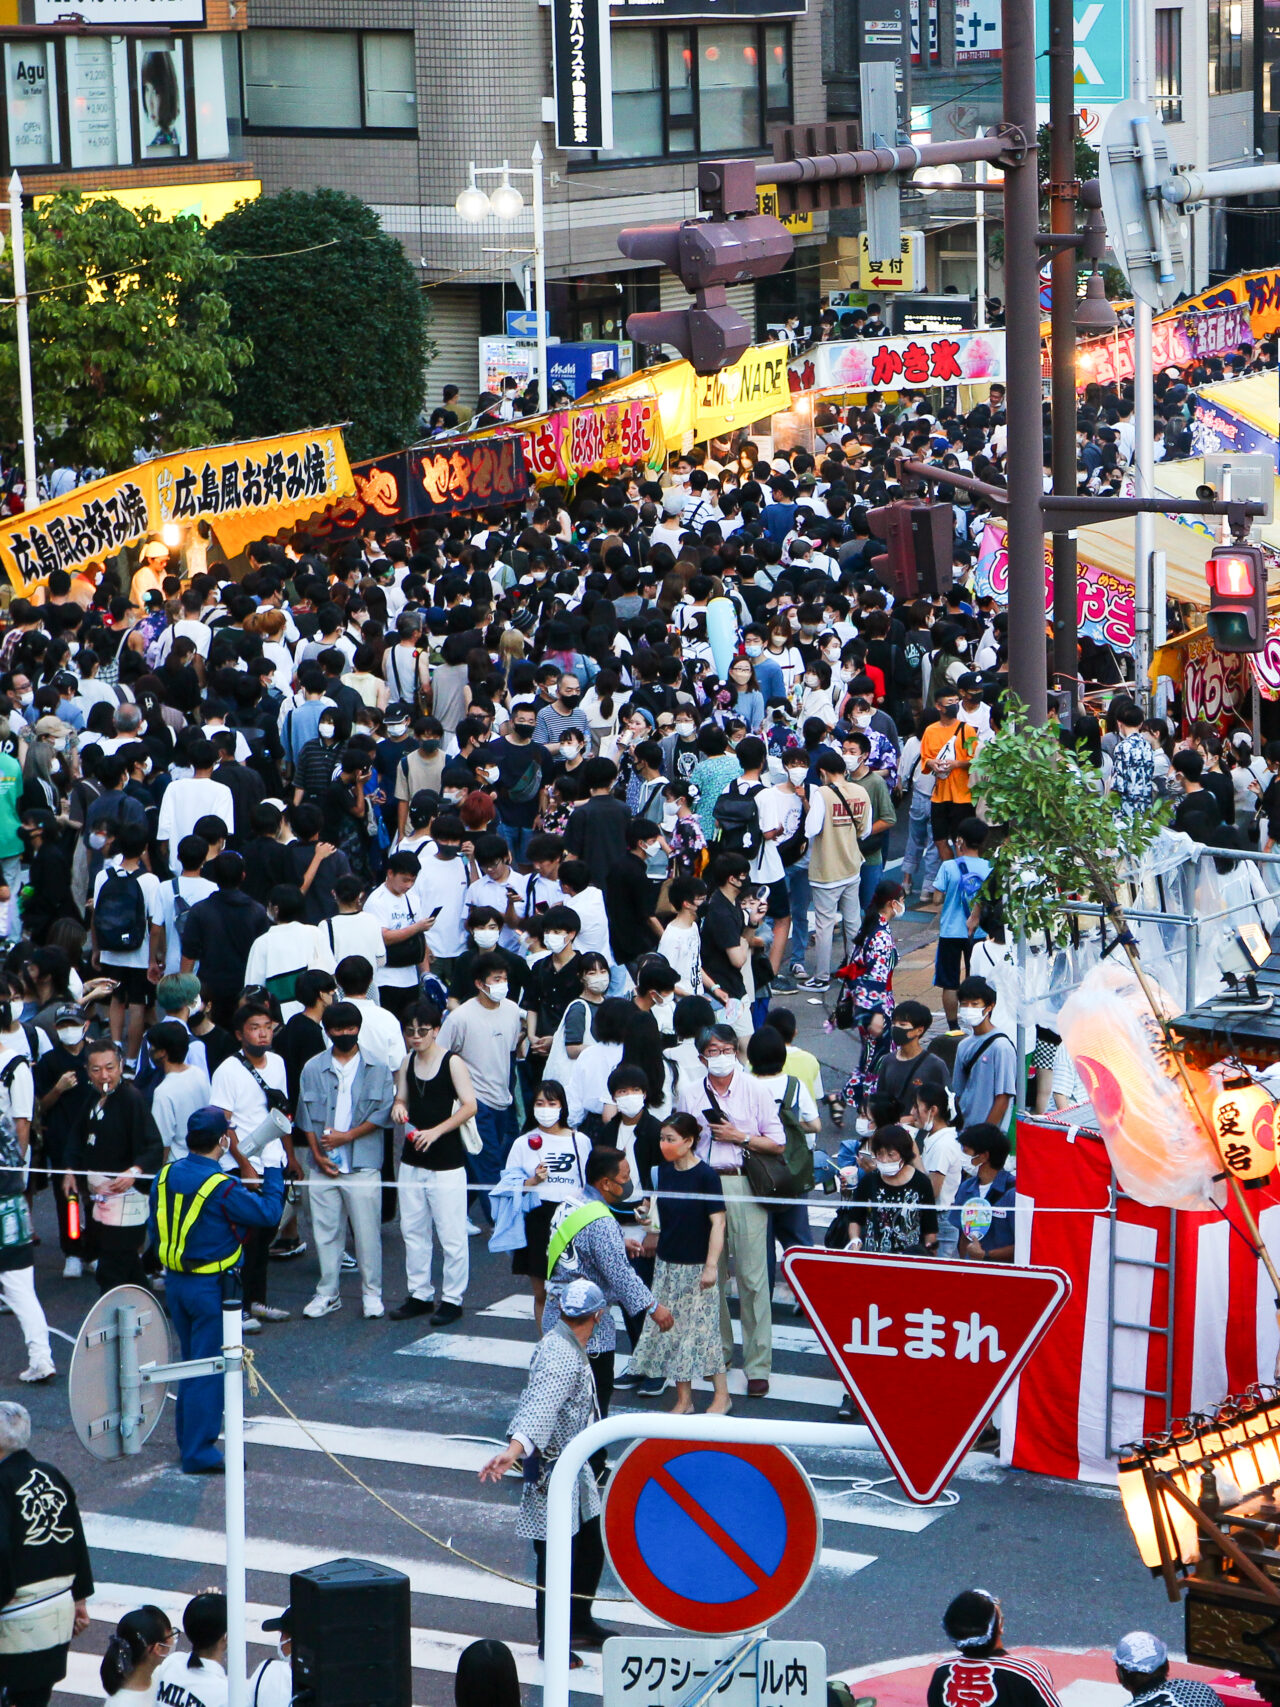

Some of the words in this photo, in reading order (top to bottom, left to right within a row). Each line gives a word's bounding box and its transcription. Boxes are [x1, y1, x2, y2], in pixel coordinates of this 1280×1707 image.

[894, 9, 901, 19] 3
[17, 61, 45, 84] Agu
[570, 0, 588, 143] 水ハウス不動産東京
[869, 259, 904, 273] 受付
[550, 363, 576, 374] Asahi
[872, 339, 962, 385] かき氷
[1093, 324, 1185, 386] 宝石さん
[172, 444, 328, 518] 広島風お好み焼
[9, 484, 149, 585] 広島風お好み焼
[1218, 1101, 1252, 1171] 愛宕
[842, 1303, 1007, 1364] 止まれ
